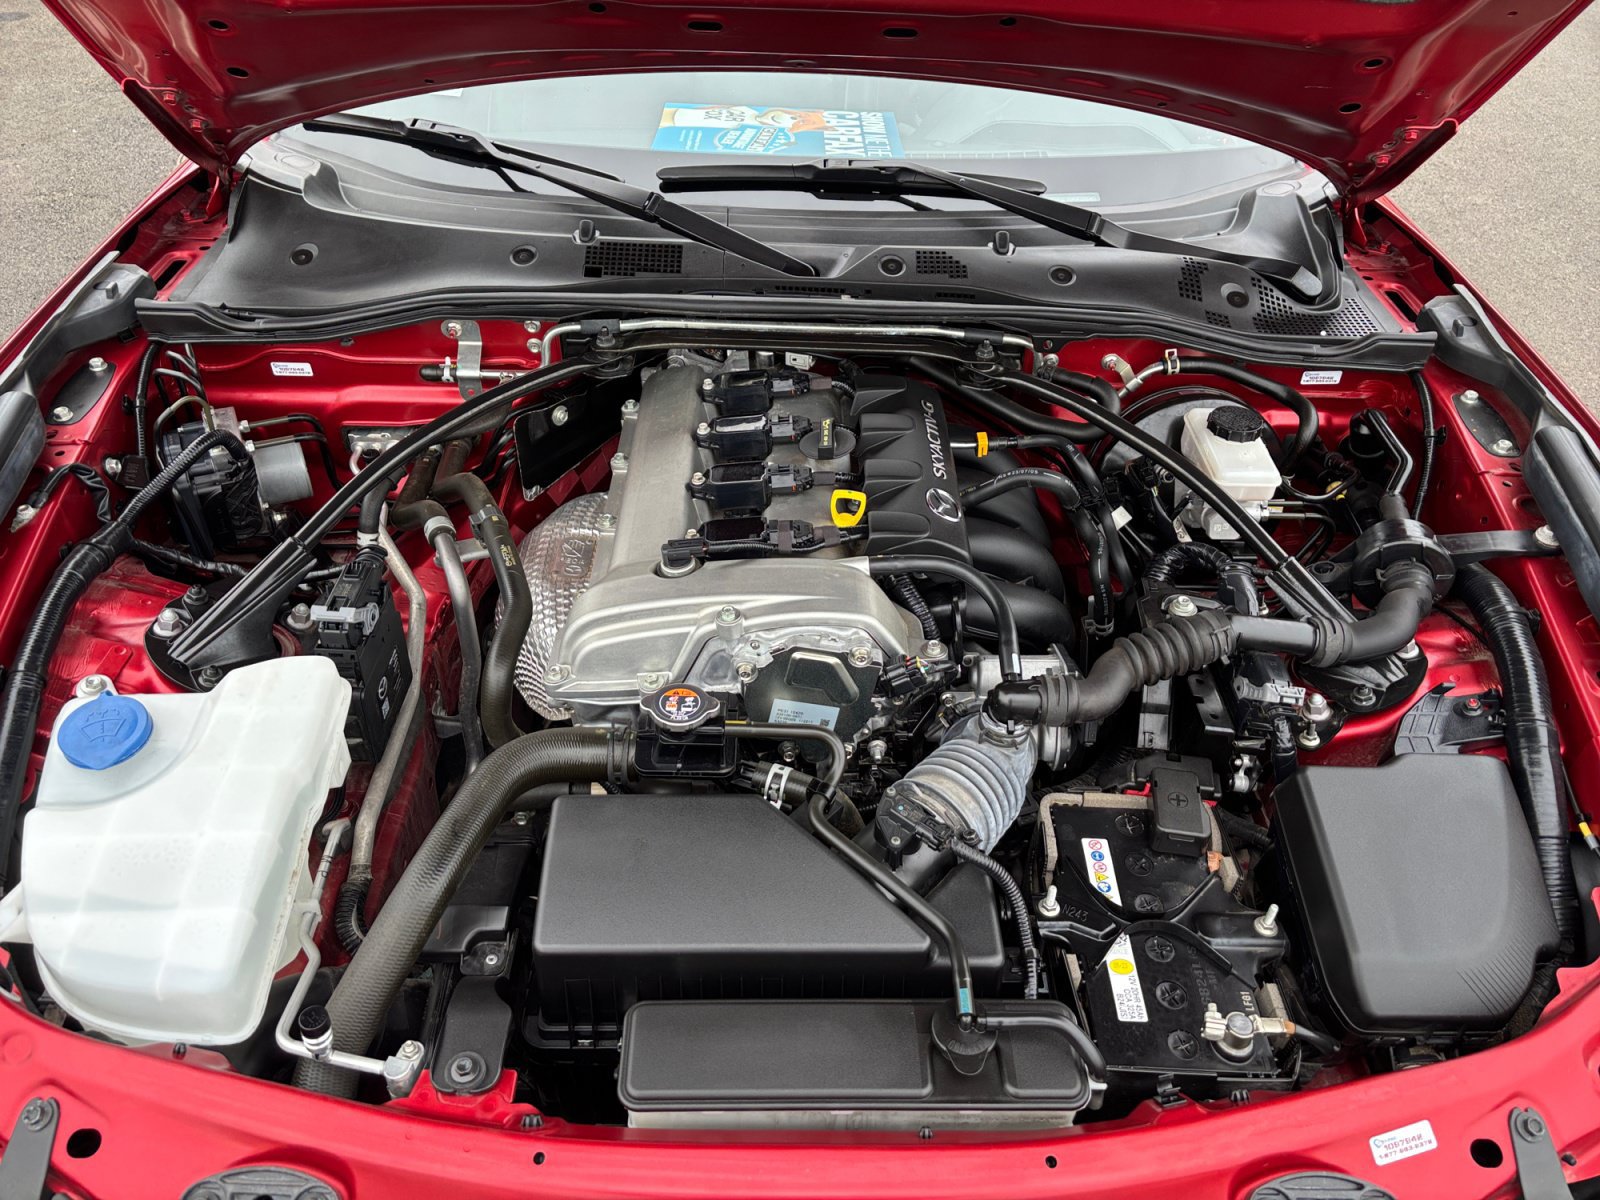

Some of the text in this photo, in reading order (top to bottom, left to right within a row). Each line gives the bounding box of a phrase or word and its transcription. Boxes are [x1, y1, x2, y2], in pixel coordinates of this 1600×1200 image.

[822, 111, 866, 158] CARFAX
[860, 112, 892, 158] SHOW ME THE
[920, 399, 947, 480] SKYACTIV-G
[1062, 904, 1089, 922] N243
[1123, 988, 1137, 1020] CCA 325A
[1128, 975, 1145, 1020] 12V 20HR 45Ah
